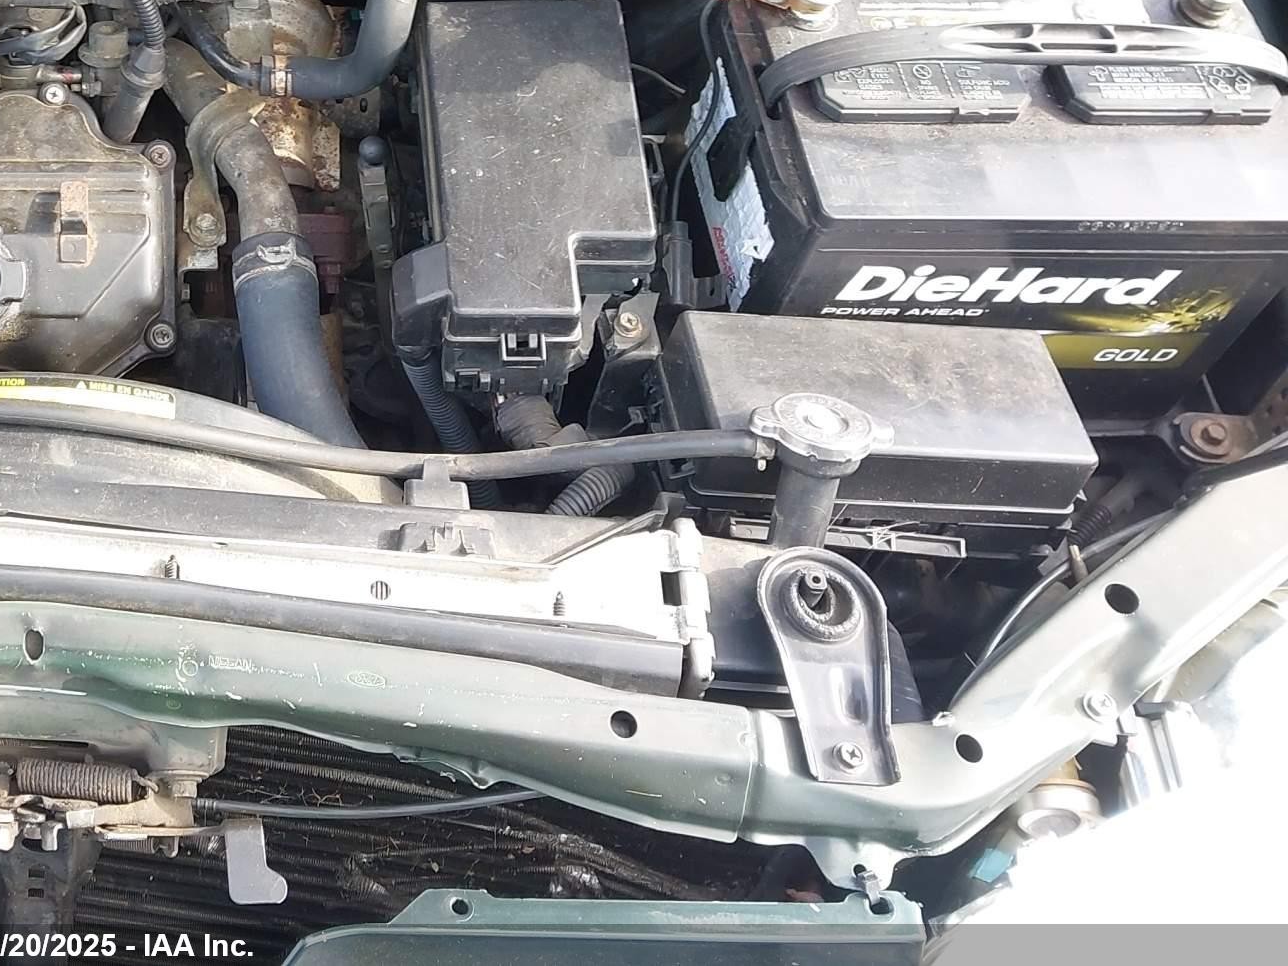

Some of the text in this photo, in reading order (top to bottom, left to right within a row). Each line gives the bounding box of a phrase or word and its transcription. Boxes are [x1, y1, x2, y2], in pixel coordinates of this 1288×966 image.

[835, 264, 1183, 306] DieHard
[819, 306, 985, 318] POWER AHEAD
[1093, 347, 1179, 363] GOLD
[88, 381, 115, 392] MISE
[116, 384, 132, 395] EN
